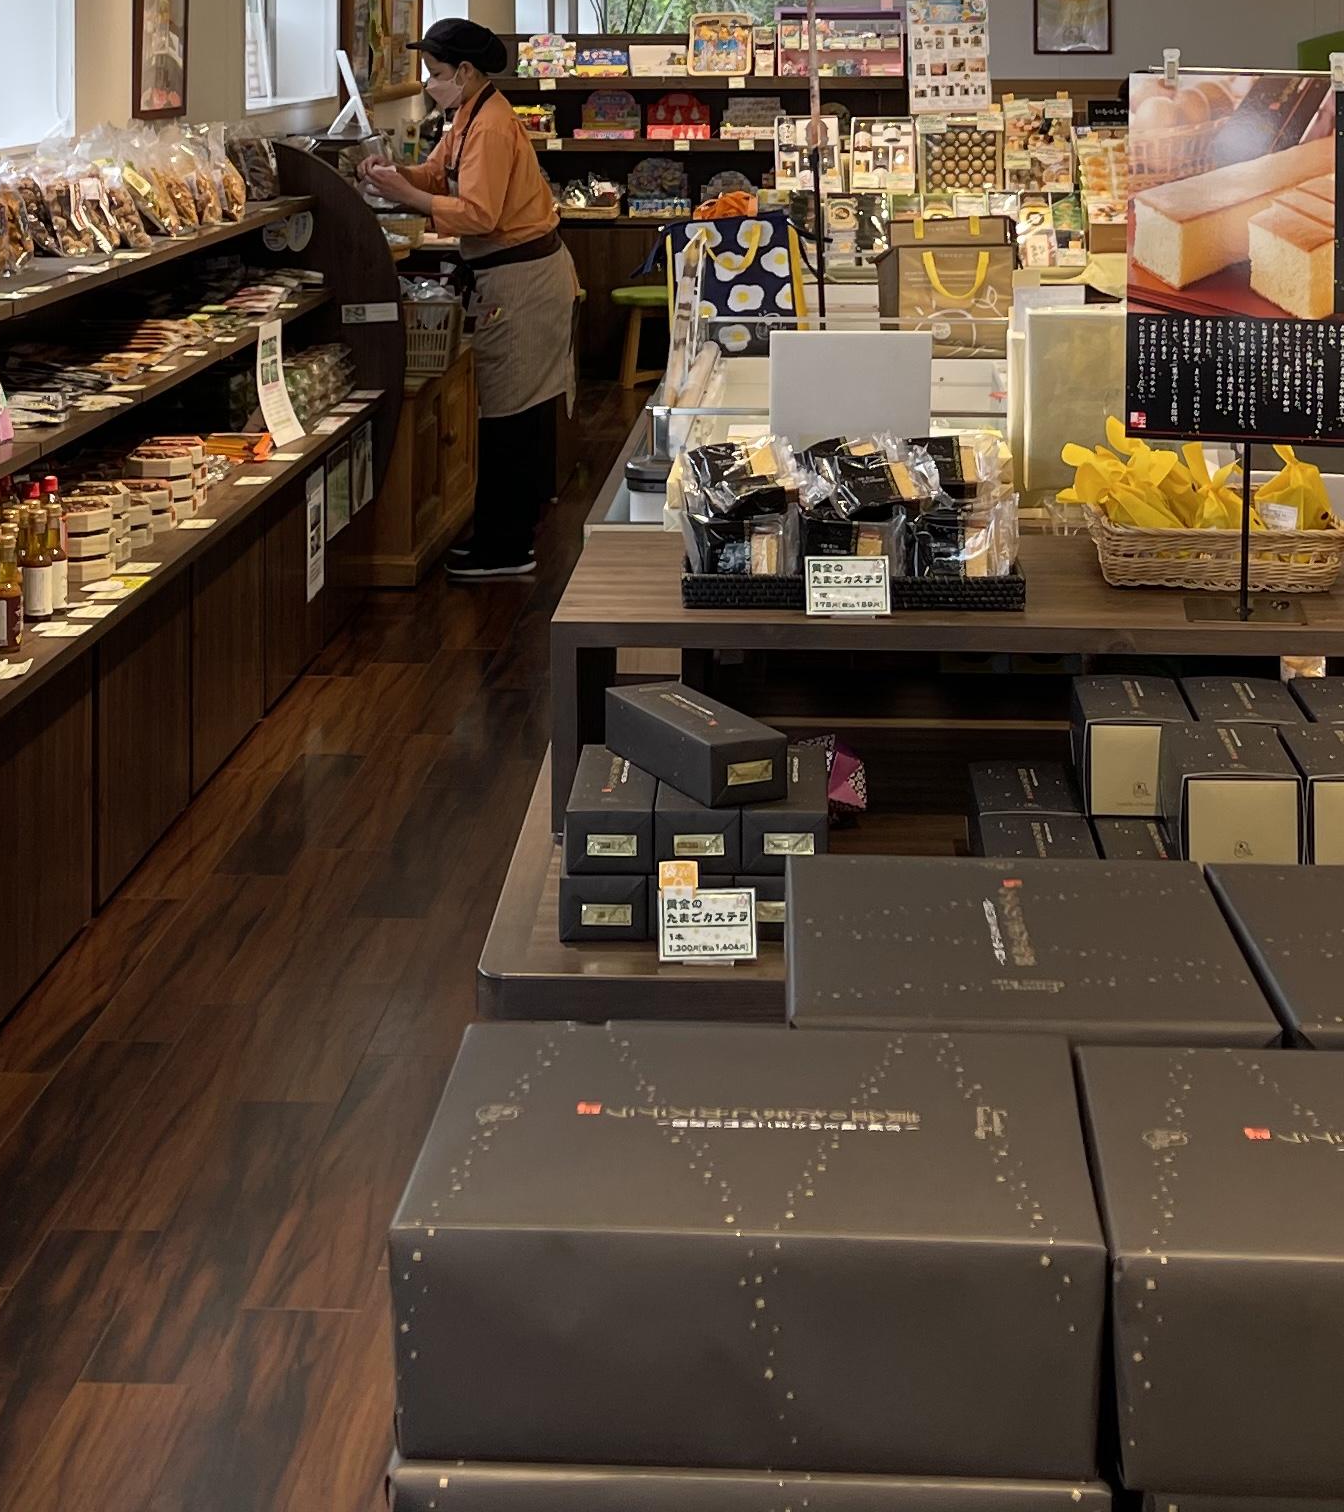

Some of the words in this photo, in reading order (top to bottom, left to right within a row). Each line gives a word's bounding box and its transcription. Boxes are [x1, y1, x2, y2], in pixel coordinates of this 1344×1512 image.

[812, 575, 883, 585] たまごカステラ
[666, 898, 703, 910] 黄金の
[666, 911, 749, 924] たまごカステラ
